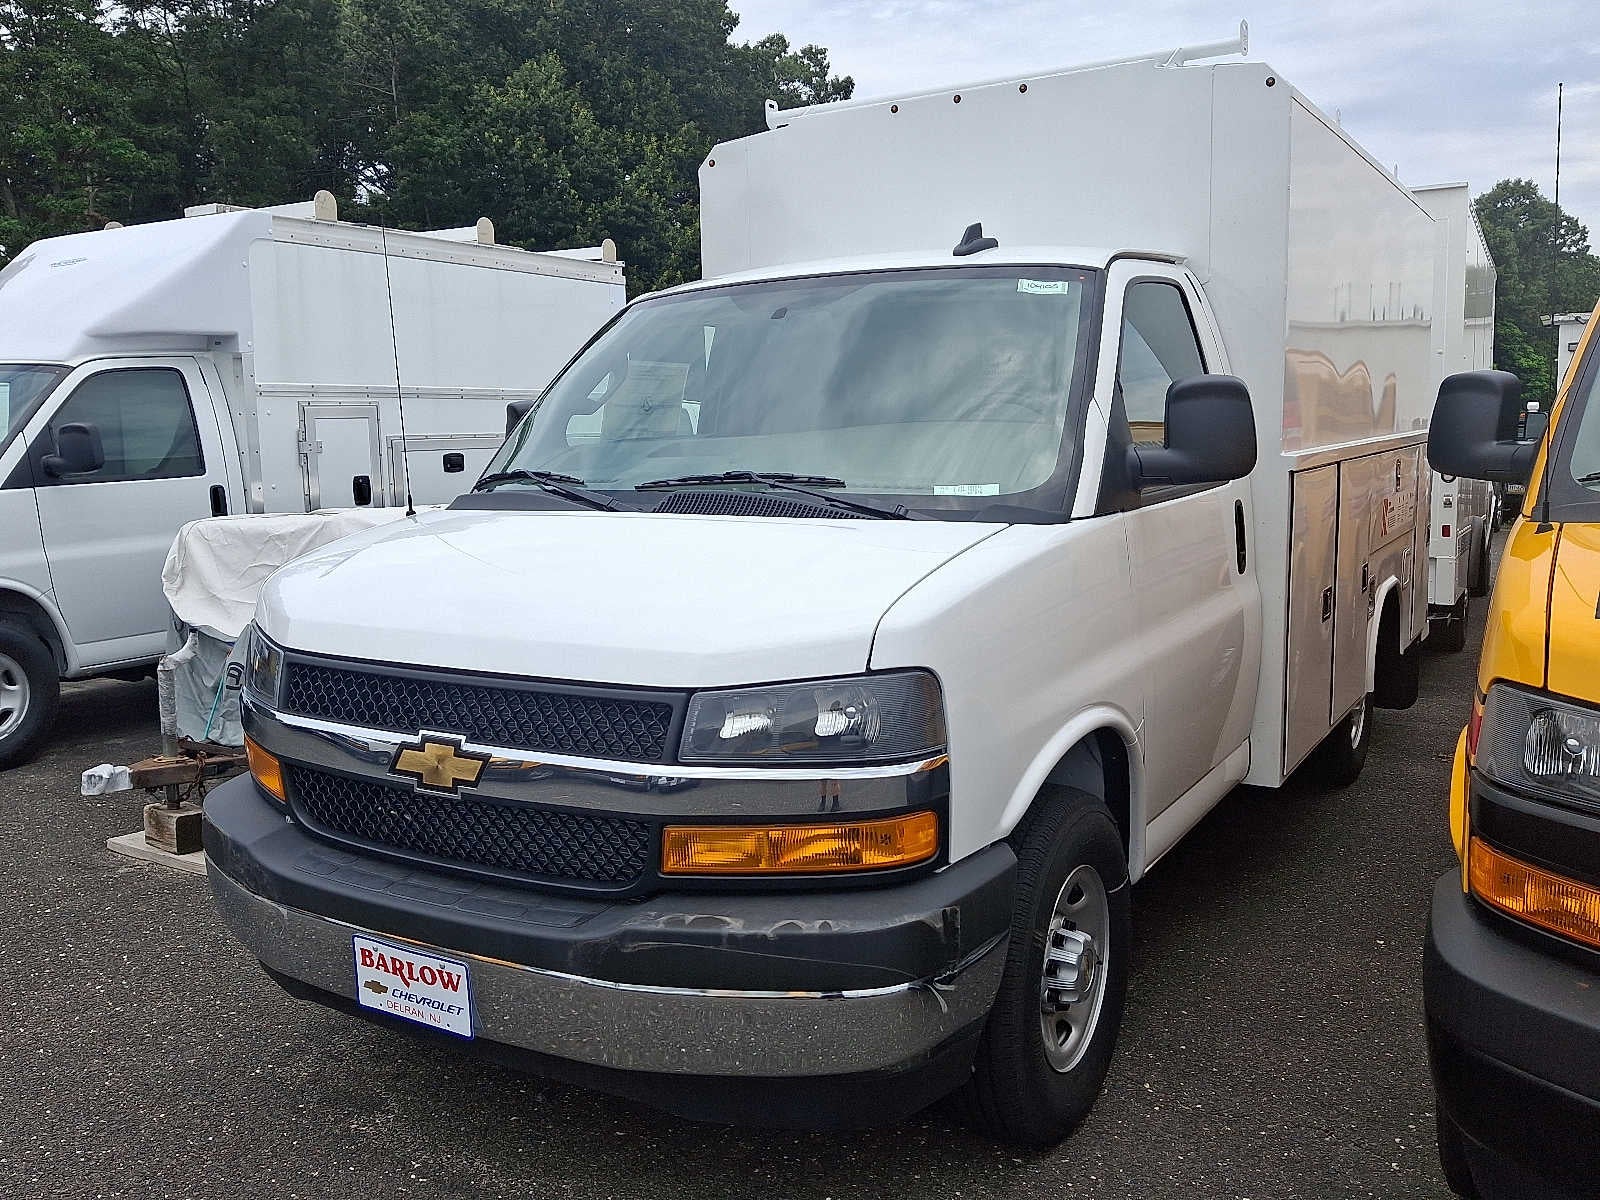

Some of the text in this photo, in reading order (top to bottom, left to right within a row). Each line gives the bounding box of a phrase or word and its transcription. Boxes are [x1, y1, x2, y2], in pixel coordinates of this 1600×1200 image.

[359, 948, 461, 992] BARLOW
[391, 988, 464, 1015] CHEVROLET
[429, 1012, 441, 1023] NJ
